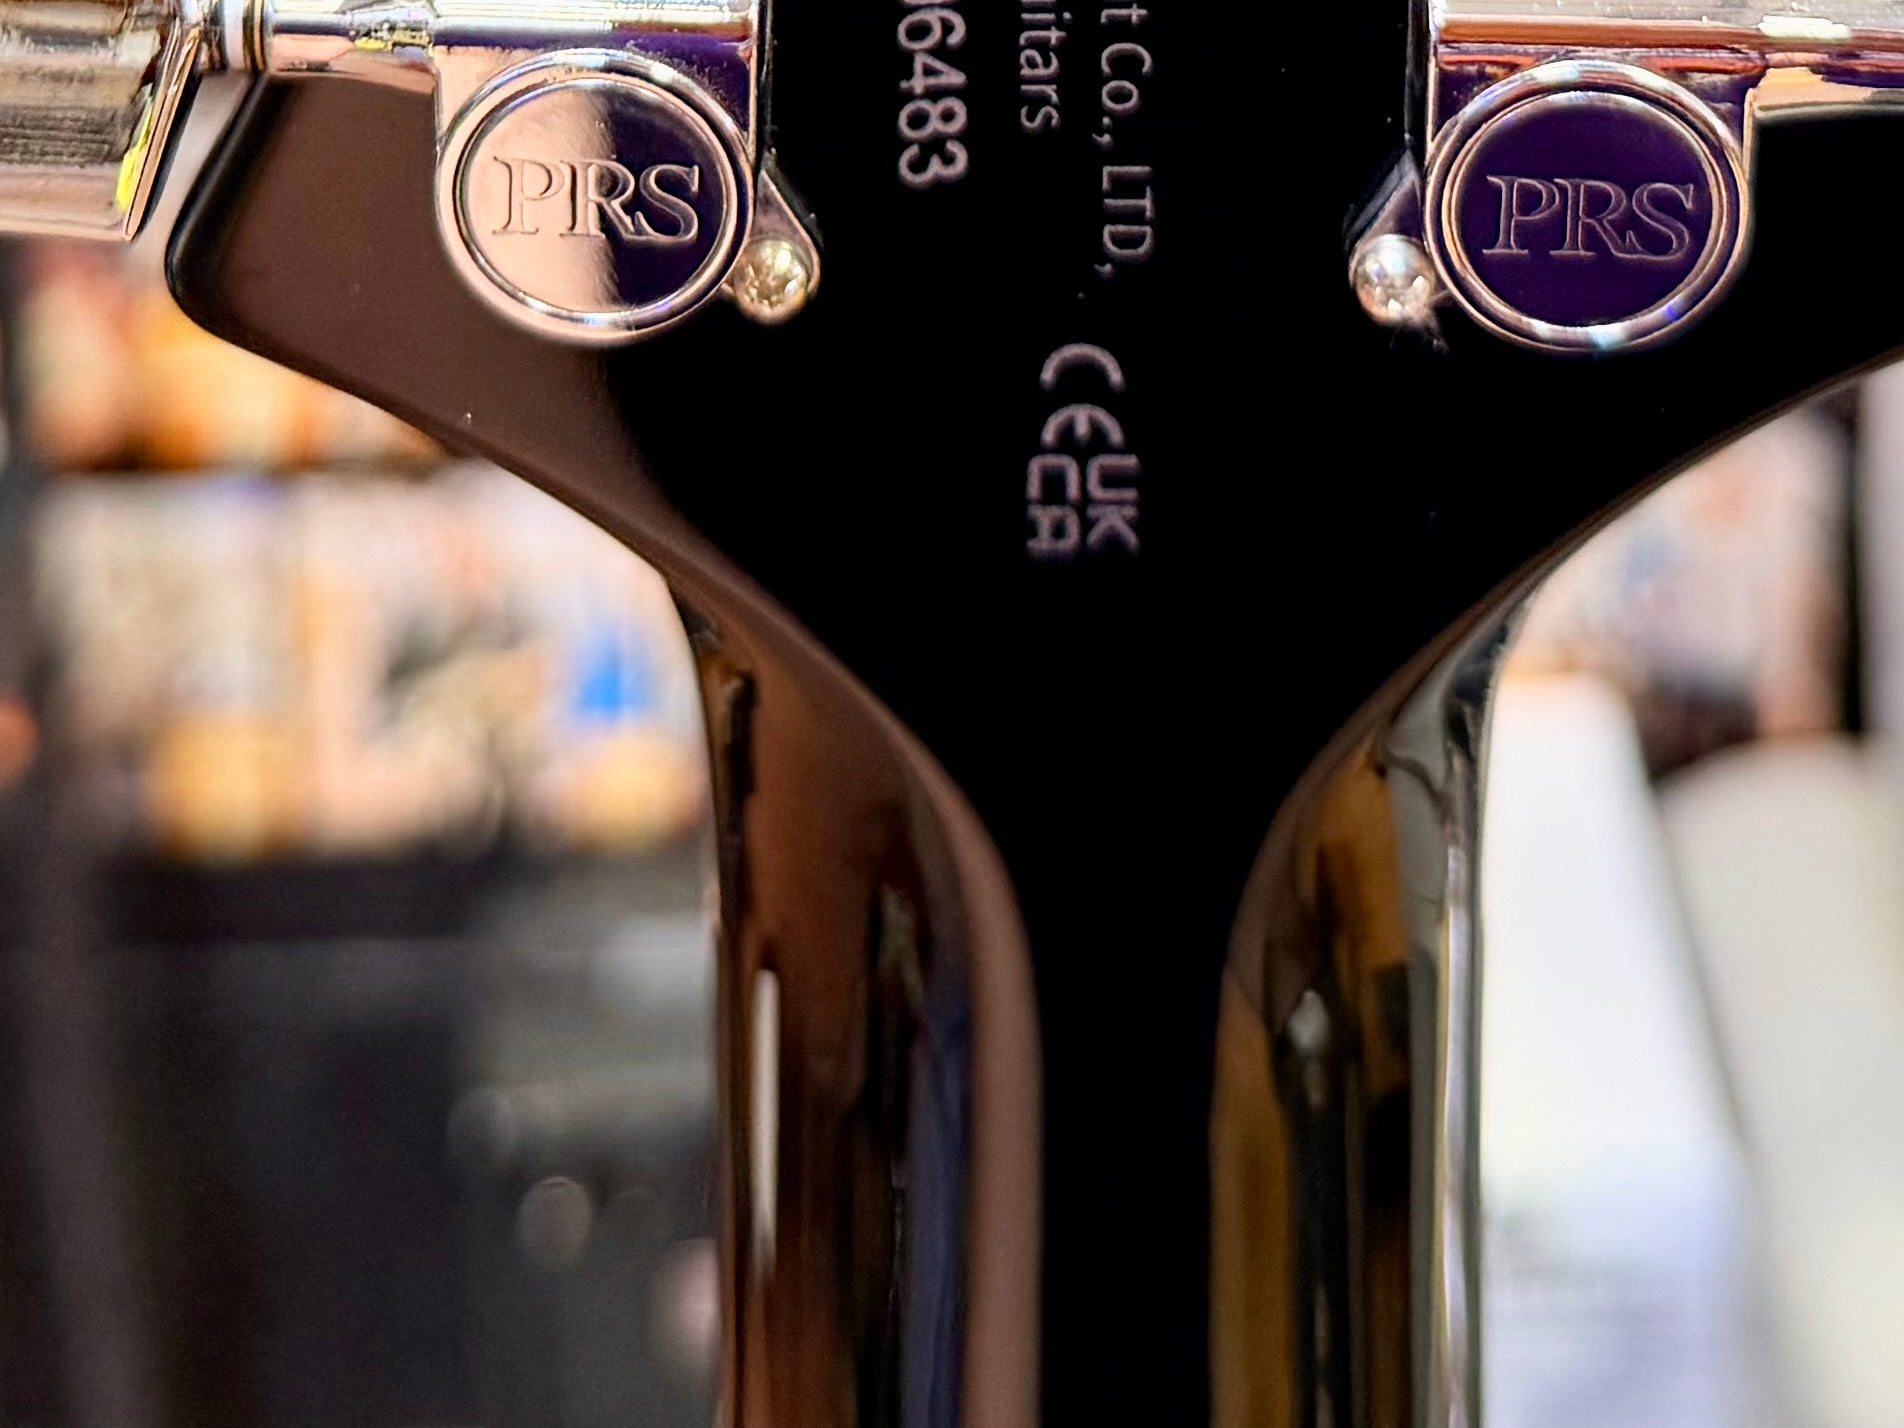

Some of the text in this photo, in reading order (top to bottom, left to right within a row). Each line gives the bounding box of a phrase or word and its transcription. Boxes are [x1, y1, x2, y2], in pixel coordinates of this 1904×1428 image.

[1092, 42, 1152, 145] Co.,
[490, 155, 700, 246] PRS
[1094, 165, 1154, 278] LTD,
[1483, 175, 1696, 261] PRS
